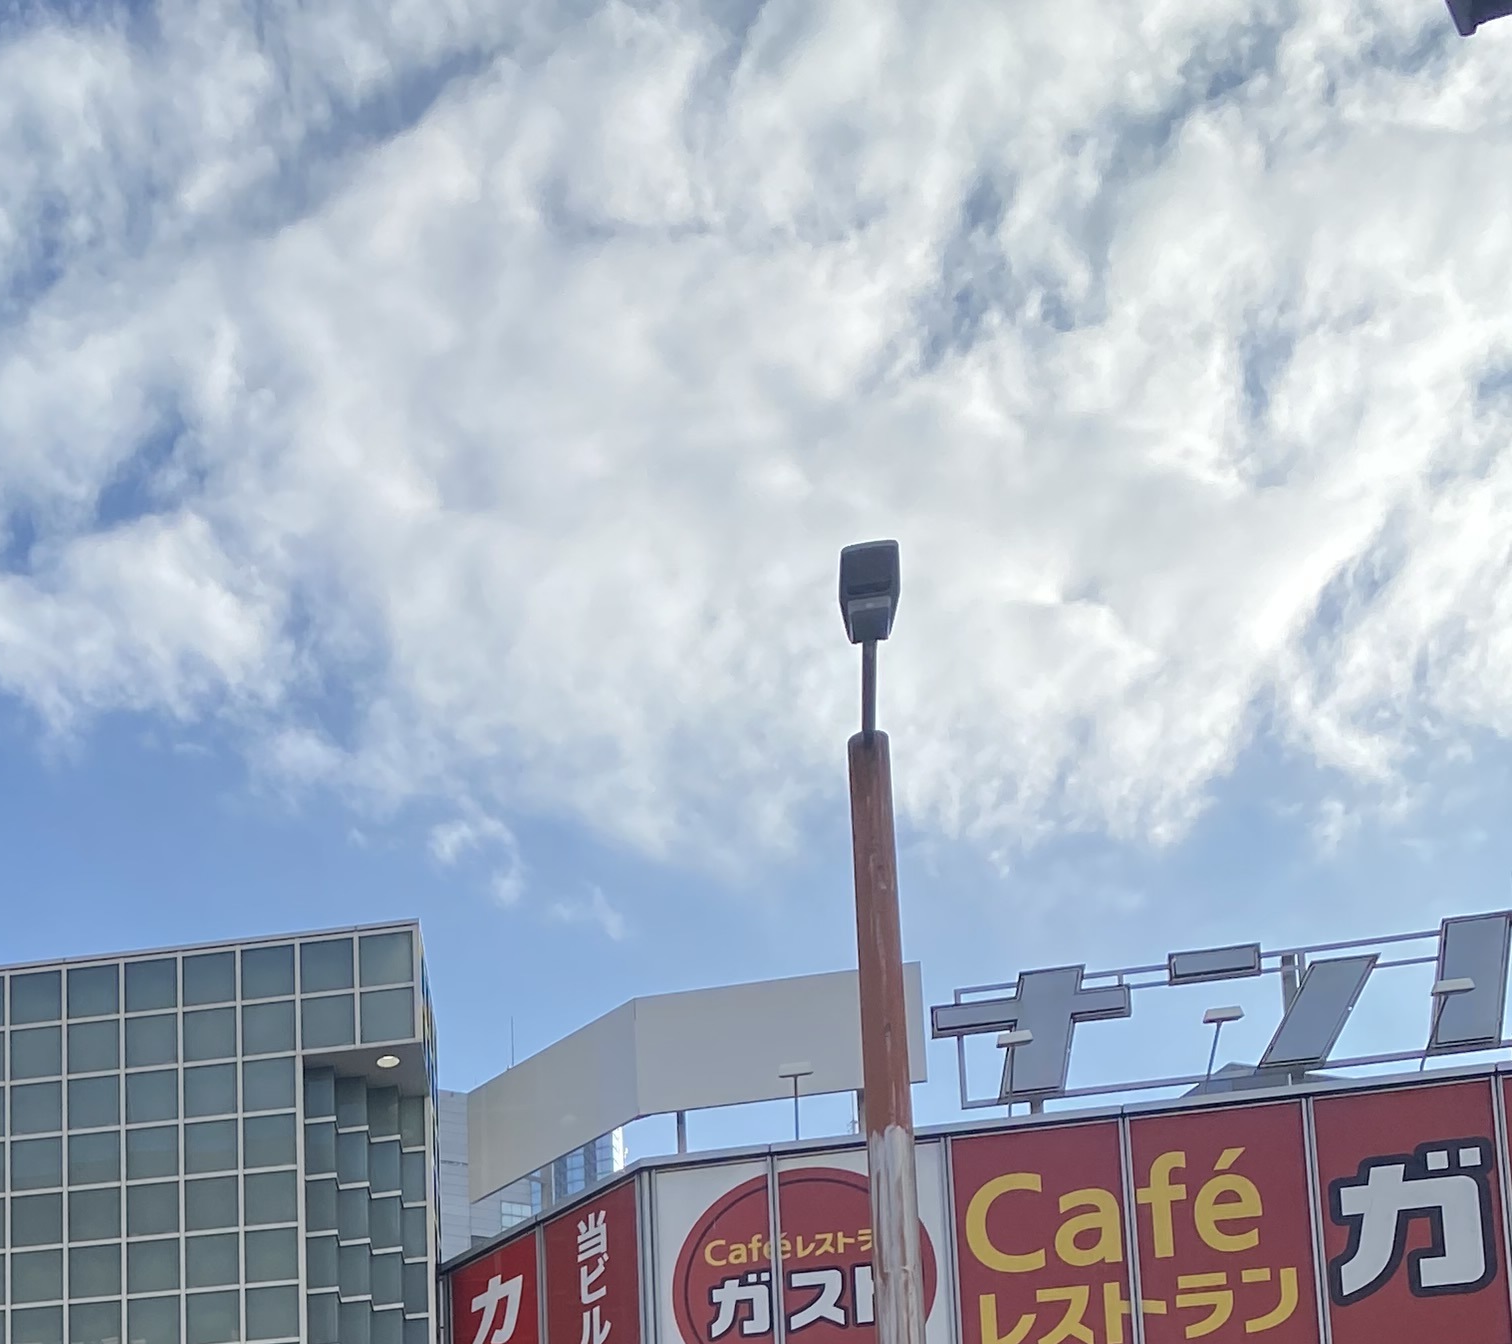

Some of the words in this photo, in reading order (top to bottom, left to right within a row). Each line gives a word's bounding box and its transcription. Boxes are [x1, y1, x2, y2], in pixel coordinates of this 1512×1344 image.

[705, 1228, 792, 1267] Café
[796, 1229, 874, 1260] レストラ
[965, 1147, 1264, 1275] Café
[1334, 1138, 1496, 1302] ガ
